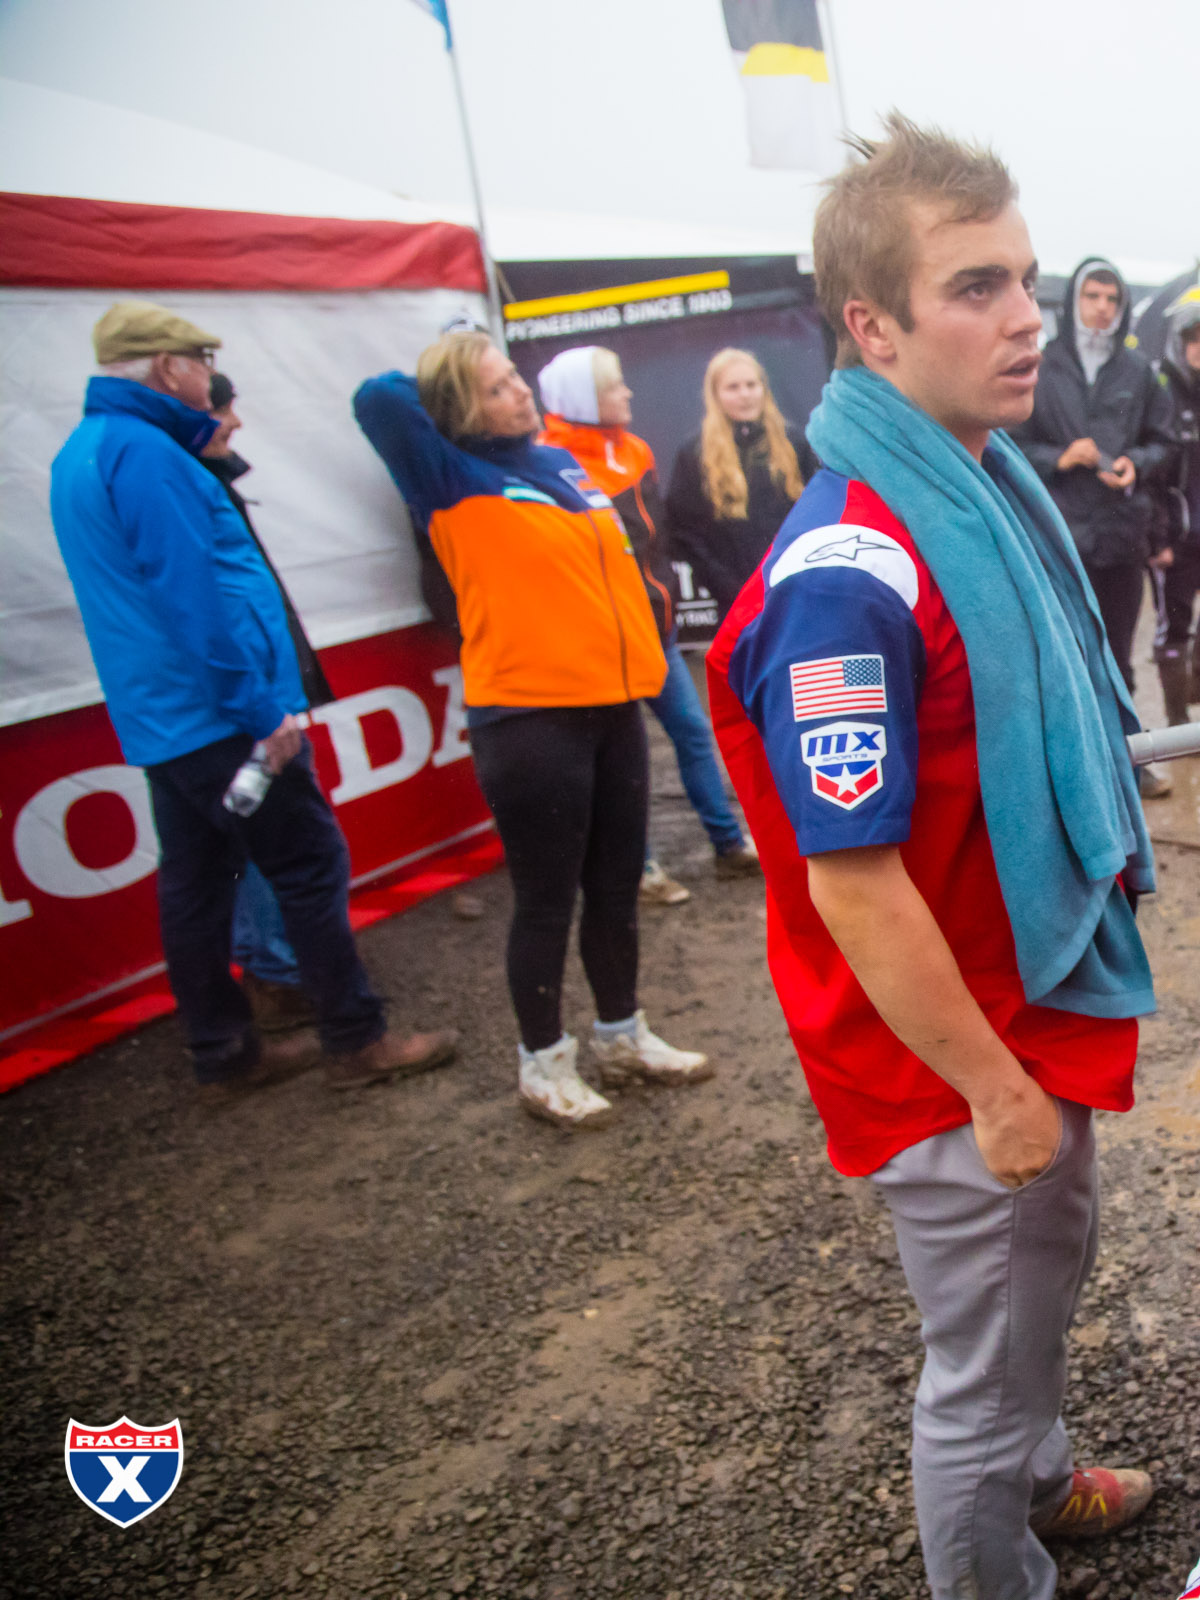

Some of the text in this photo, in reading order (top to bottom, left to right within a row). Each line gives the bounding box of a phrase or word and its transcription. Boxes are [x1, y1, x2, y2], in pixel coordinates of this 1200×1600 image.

[623, 295, 685, 325] SINCE
[807, 730, 882, 758] MX
[822, 753, 868, 763] SPORTS
